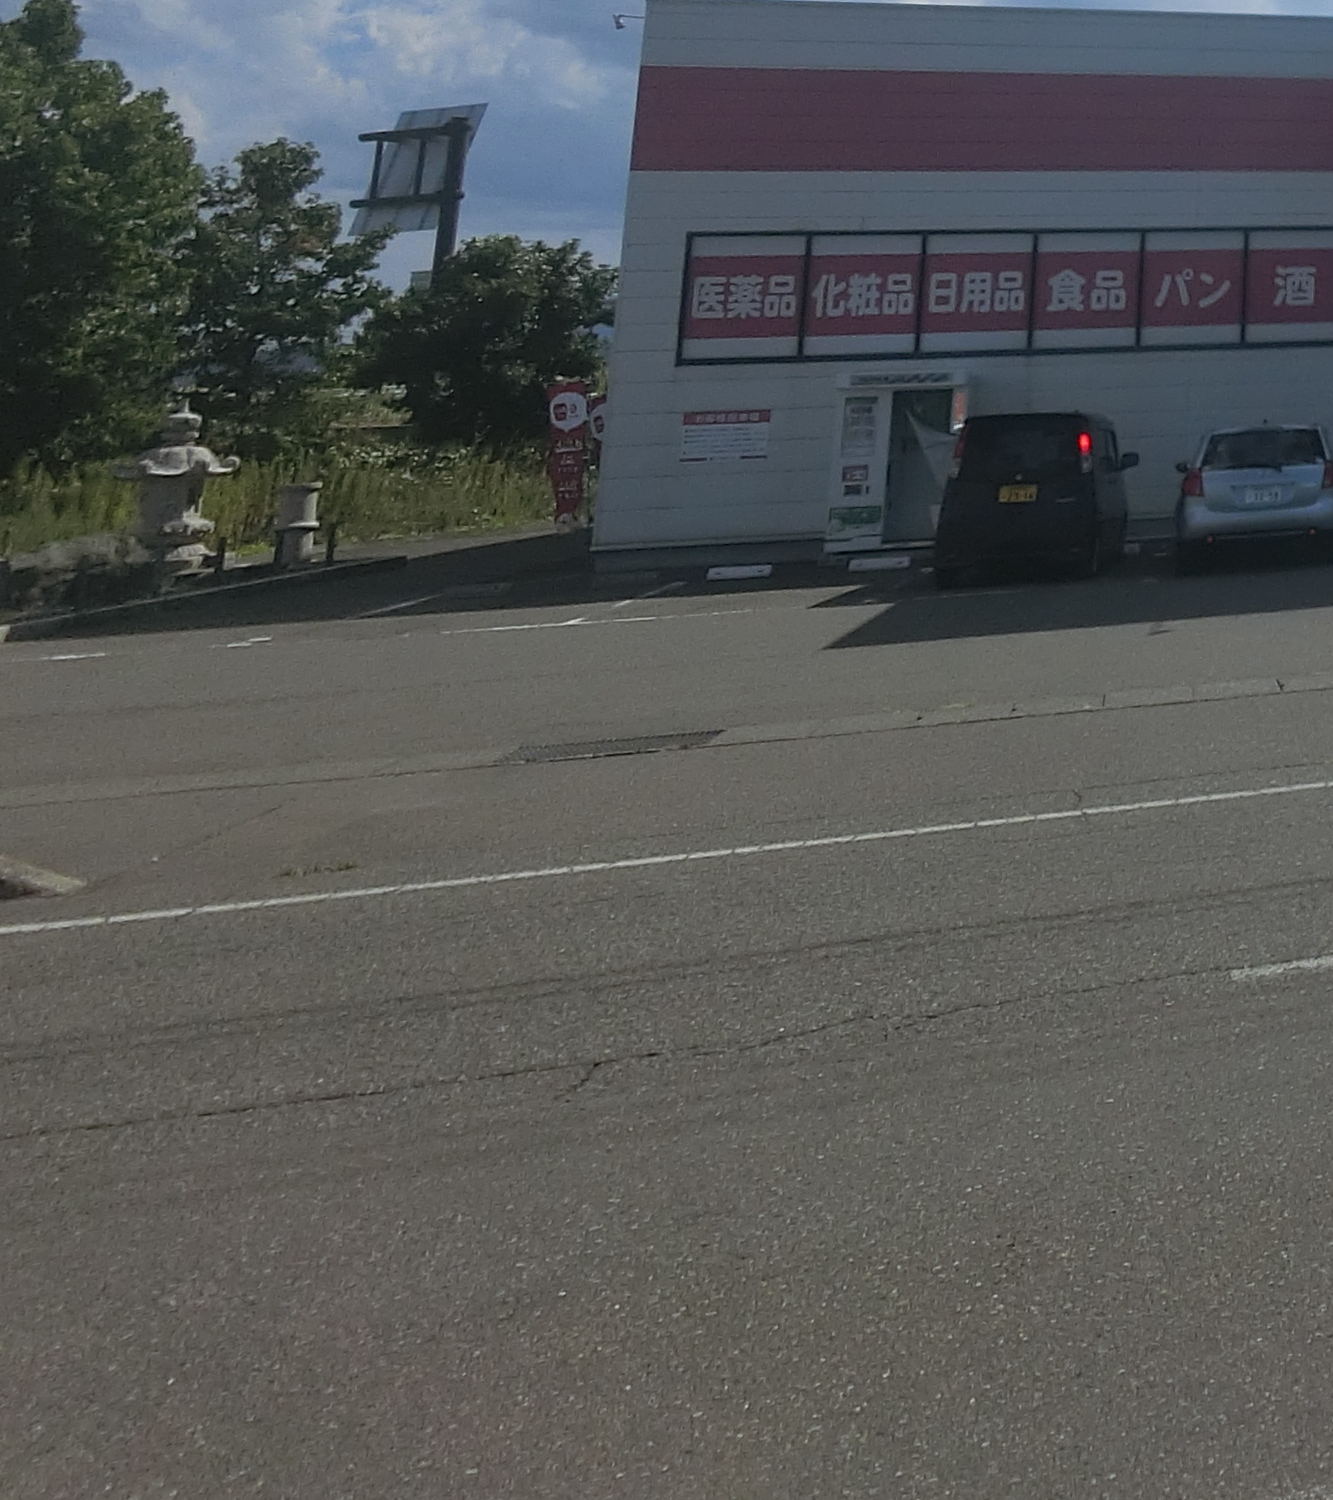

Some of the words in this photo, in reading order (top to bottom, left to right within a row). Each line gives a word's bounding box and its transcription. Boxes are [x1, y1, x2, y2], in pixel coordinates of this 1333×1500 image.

[691, 274, 798, 320] 医薬品
[811, 273, 915, 318] 化粧品
[927, 269, 1026, 314] 日用品
[1045, 269, 1128, 313] 食品
[1153, 270, 1232, 308] パン
[1273, 265, 1316, 307] 酒
